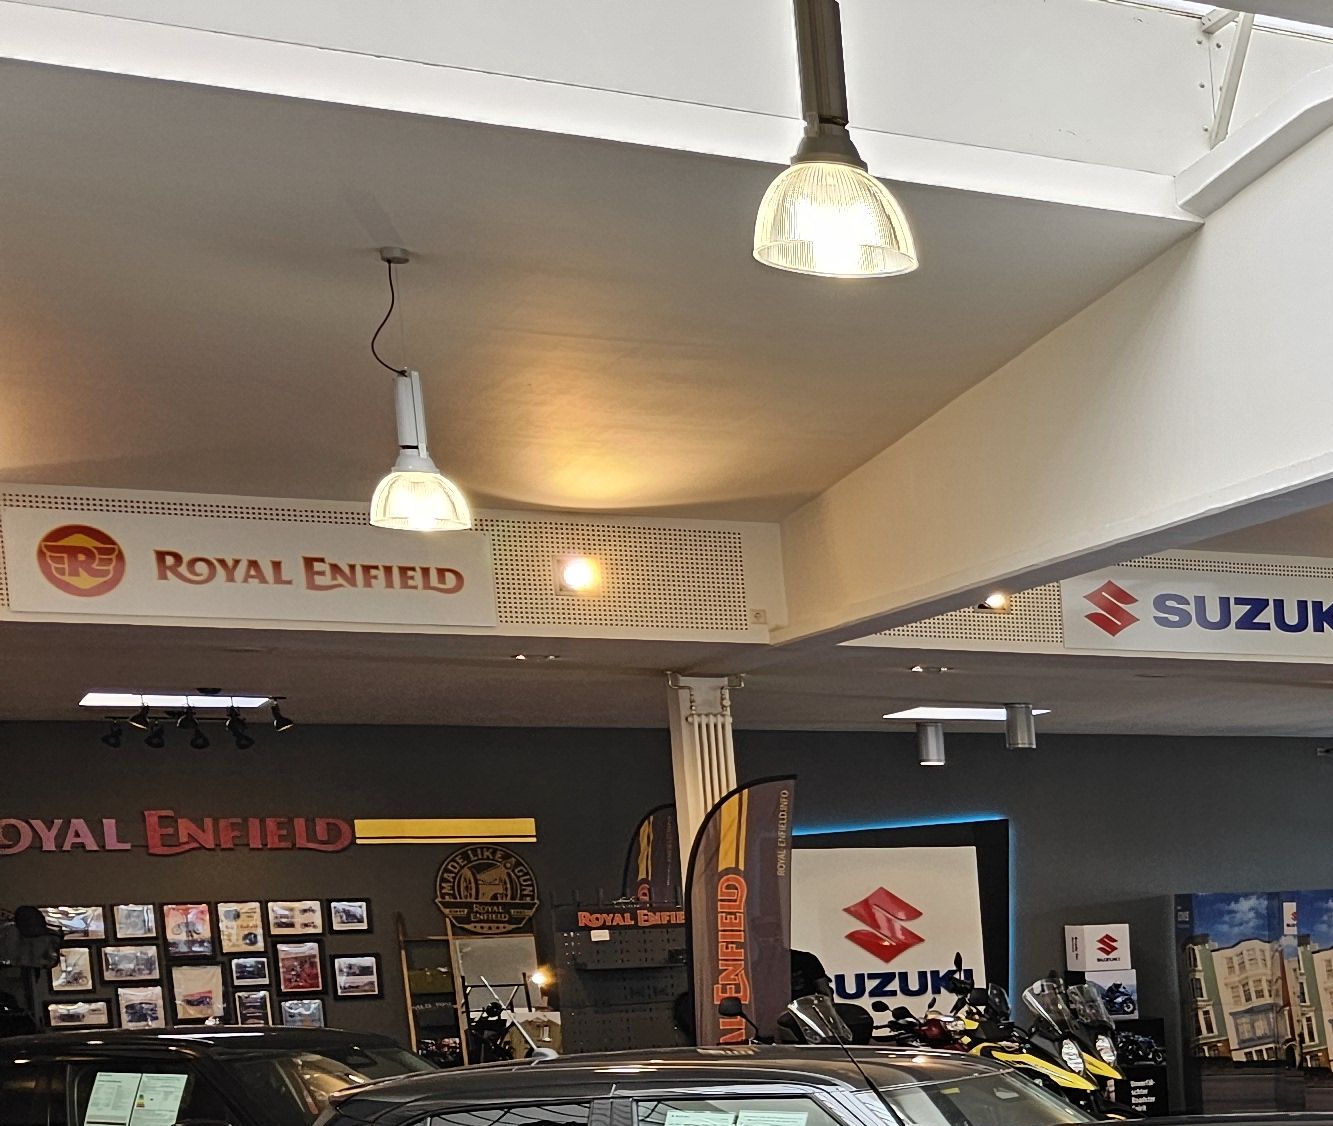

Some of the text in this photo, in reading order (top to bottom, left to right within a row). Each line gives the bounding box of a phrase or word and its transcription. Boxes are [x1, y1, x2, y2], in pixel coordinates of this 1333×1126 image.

[152, 549, 466, 595] ROYAL ENFIELD
[144, 809, 353, 856] ENFIELD
[441, 854, 468, 893] MADE
[467, 847, 506, 862] LIKE
[514, 866, 534, 895] GUN
[776, 849, 787, 877] ROYAL
[470, 912, 509, 922] ENFIELD
[472, 903, 505, 913] ROYAL
[577, 909, 686, 928] ROYAL ENFIE
[713, 873, 751, 1005] ENFIELD
[833, 968, 975, 1001] UZUKI
